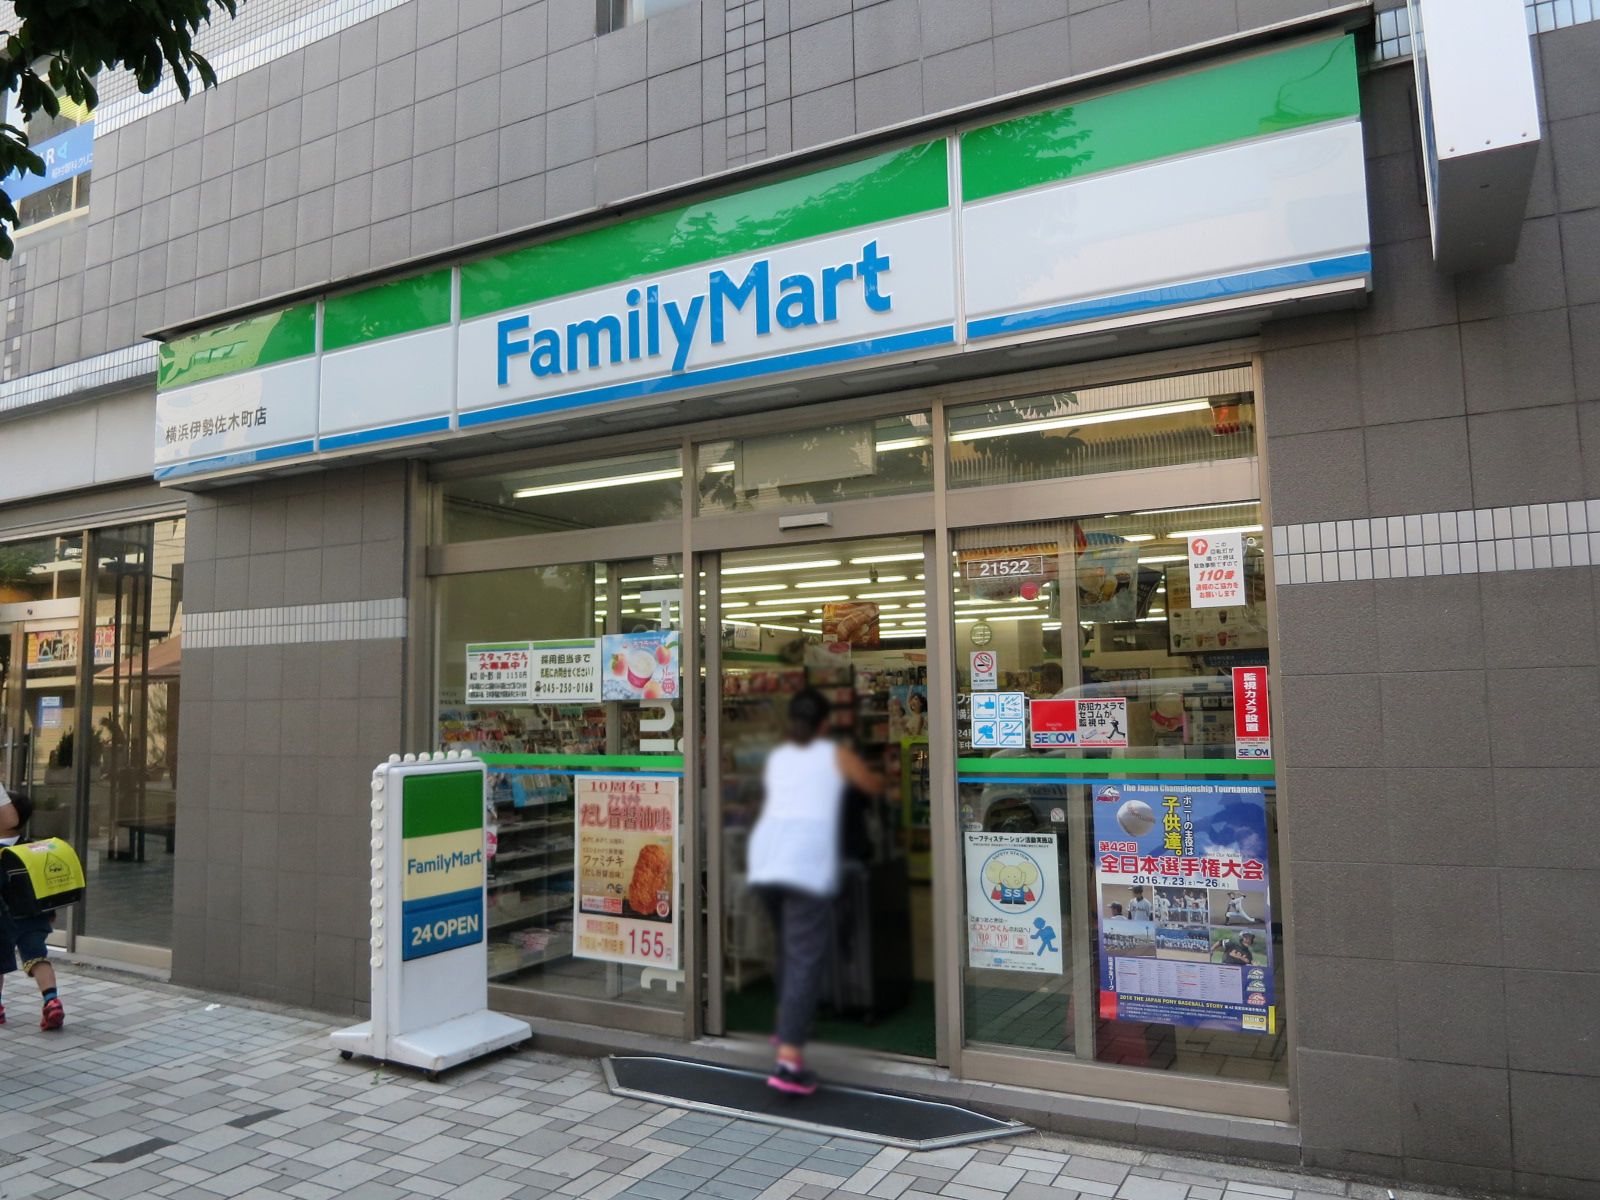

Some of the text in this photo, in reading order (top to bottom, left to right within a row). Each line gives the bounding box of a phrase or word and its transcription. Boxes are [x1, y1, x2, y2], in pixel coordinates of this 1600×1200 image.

[497, 240, 892, 386] FamilyMart
[165, 406, 267, 444] 横浜伊勢佐木町店
[980, 560, 1030, 576] 21522
[1200, 569, 1234, 581] 110番
[1196, 582, 1239, 591] 通報のご協力を
[1200, 590, 1236, 598] お願いします
[480, 652, 528, 661] スタッフさん
[541, 654, 591, 664] 採用担当まで
[543, 682, 593, 693] 045-250-0168
[1078, 702, 1125, 711] 防犯カメラで
[1243, 672, 1259, 732] 監視カメラ設置
[1079, 711, 1112, 719] セコムが
[1078, 719, 1106, 727] 監視中
[1034, 732, 1075, 743] SECOM
[1239, 748, 1268, 756] SECOM
[1123, 784, 1261, 794] The Japan Championship Tournament
[1162, 795, 1183, 857] 子供達。
[1099, 842, 1137, 852] 第42回
[407, 849, 482, 875] FamilyMart
[584, 855, 624, 867] ファミチキ
[1101, 854, 1264, 880] 全日本選手権大会
[1178, 999, 1205, 1007] BASEBALL
